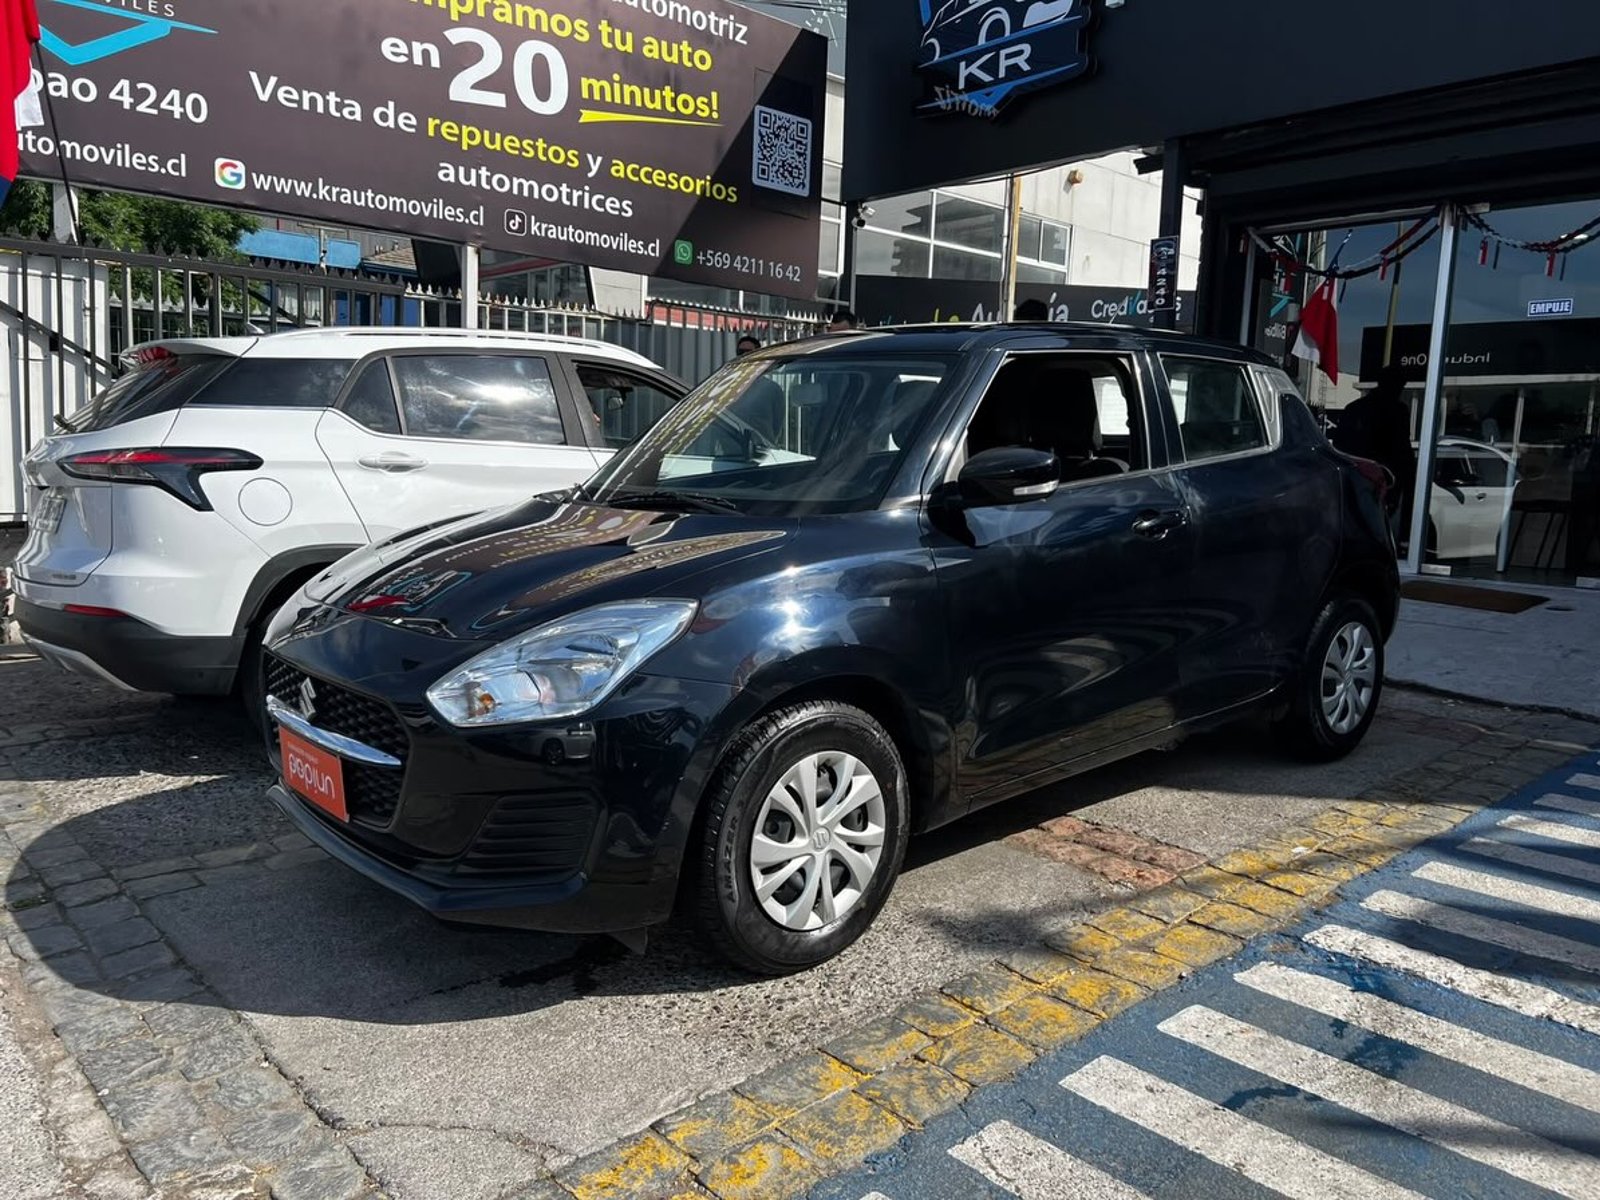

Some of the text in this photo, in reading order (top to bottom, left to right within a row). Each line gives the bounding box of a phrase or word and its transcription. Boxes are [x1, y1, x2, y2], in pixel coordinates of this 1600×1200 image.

[599, 19, 633, 53] tu
[642, 36, 712, 71] auto
[958, 43, 1032, 90] KR
[381, 27, 719, 119] en 20 minutos!
[108, 78, 208, 123] 4240
[249, 70, 738, 203] Venta de repuestos y accesorios
[251, 171, 484, 226] www.krautomoviles.cl
[437, 162, 633, 217] automotrices
[531, 215, 660, 258] krautomoviles.cl
[696, 249, 801, 282] +569 4211 16 42
[1529, 300, 1572, 315] EMPUJE
